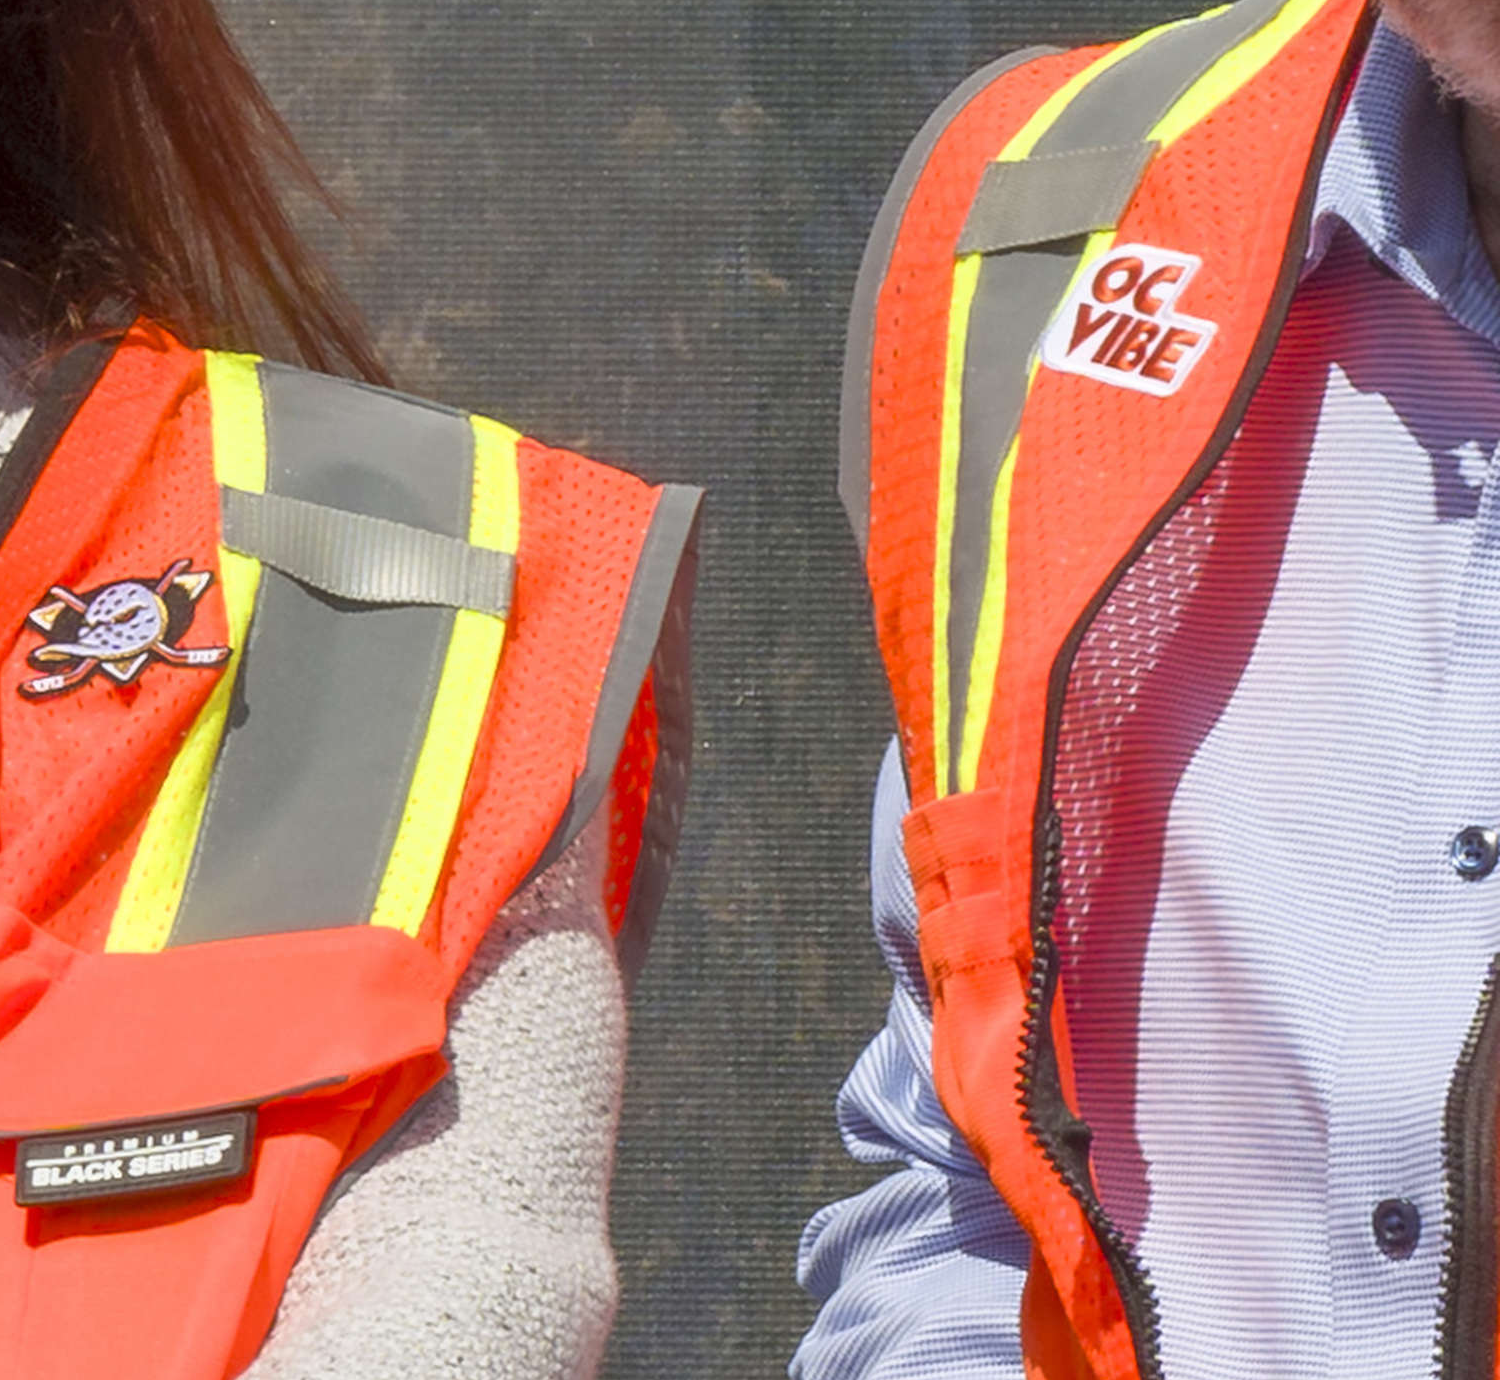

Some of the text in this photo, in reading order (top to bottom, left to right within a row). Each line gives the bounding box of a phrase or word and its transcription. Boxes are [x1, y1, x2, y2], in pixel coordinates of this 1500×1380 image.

[1091, 256, 1187, 317] OC
[1065, 303, 1204, 383] VIBE
[31, 1140, 231, 1187] BLACK SERIES
[64, 1130, 199, 1158] PREMIUM
